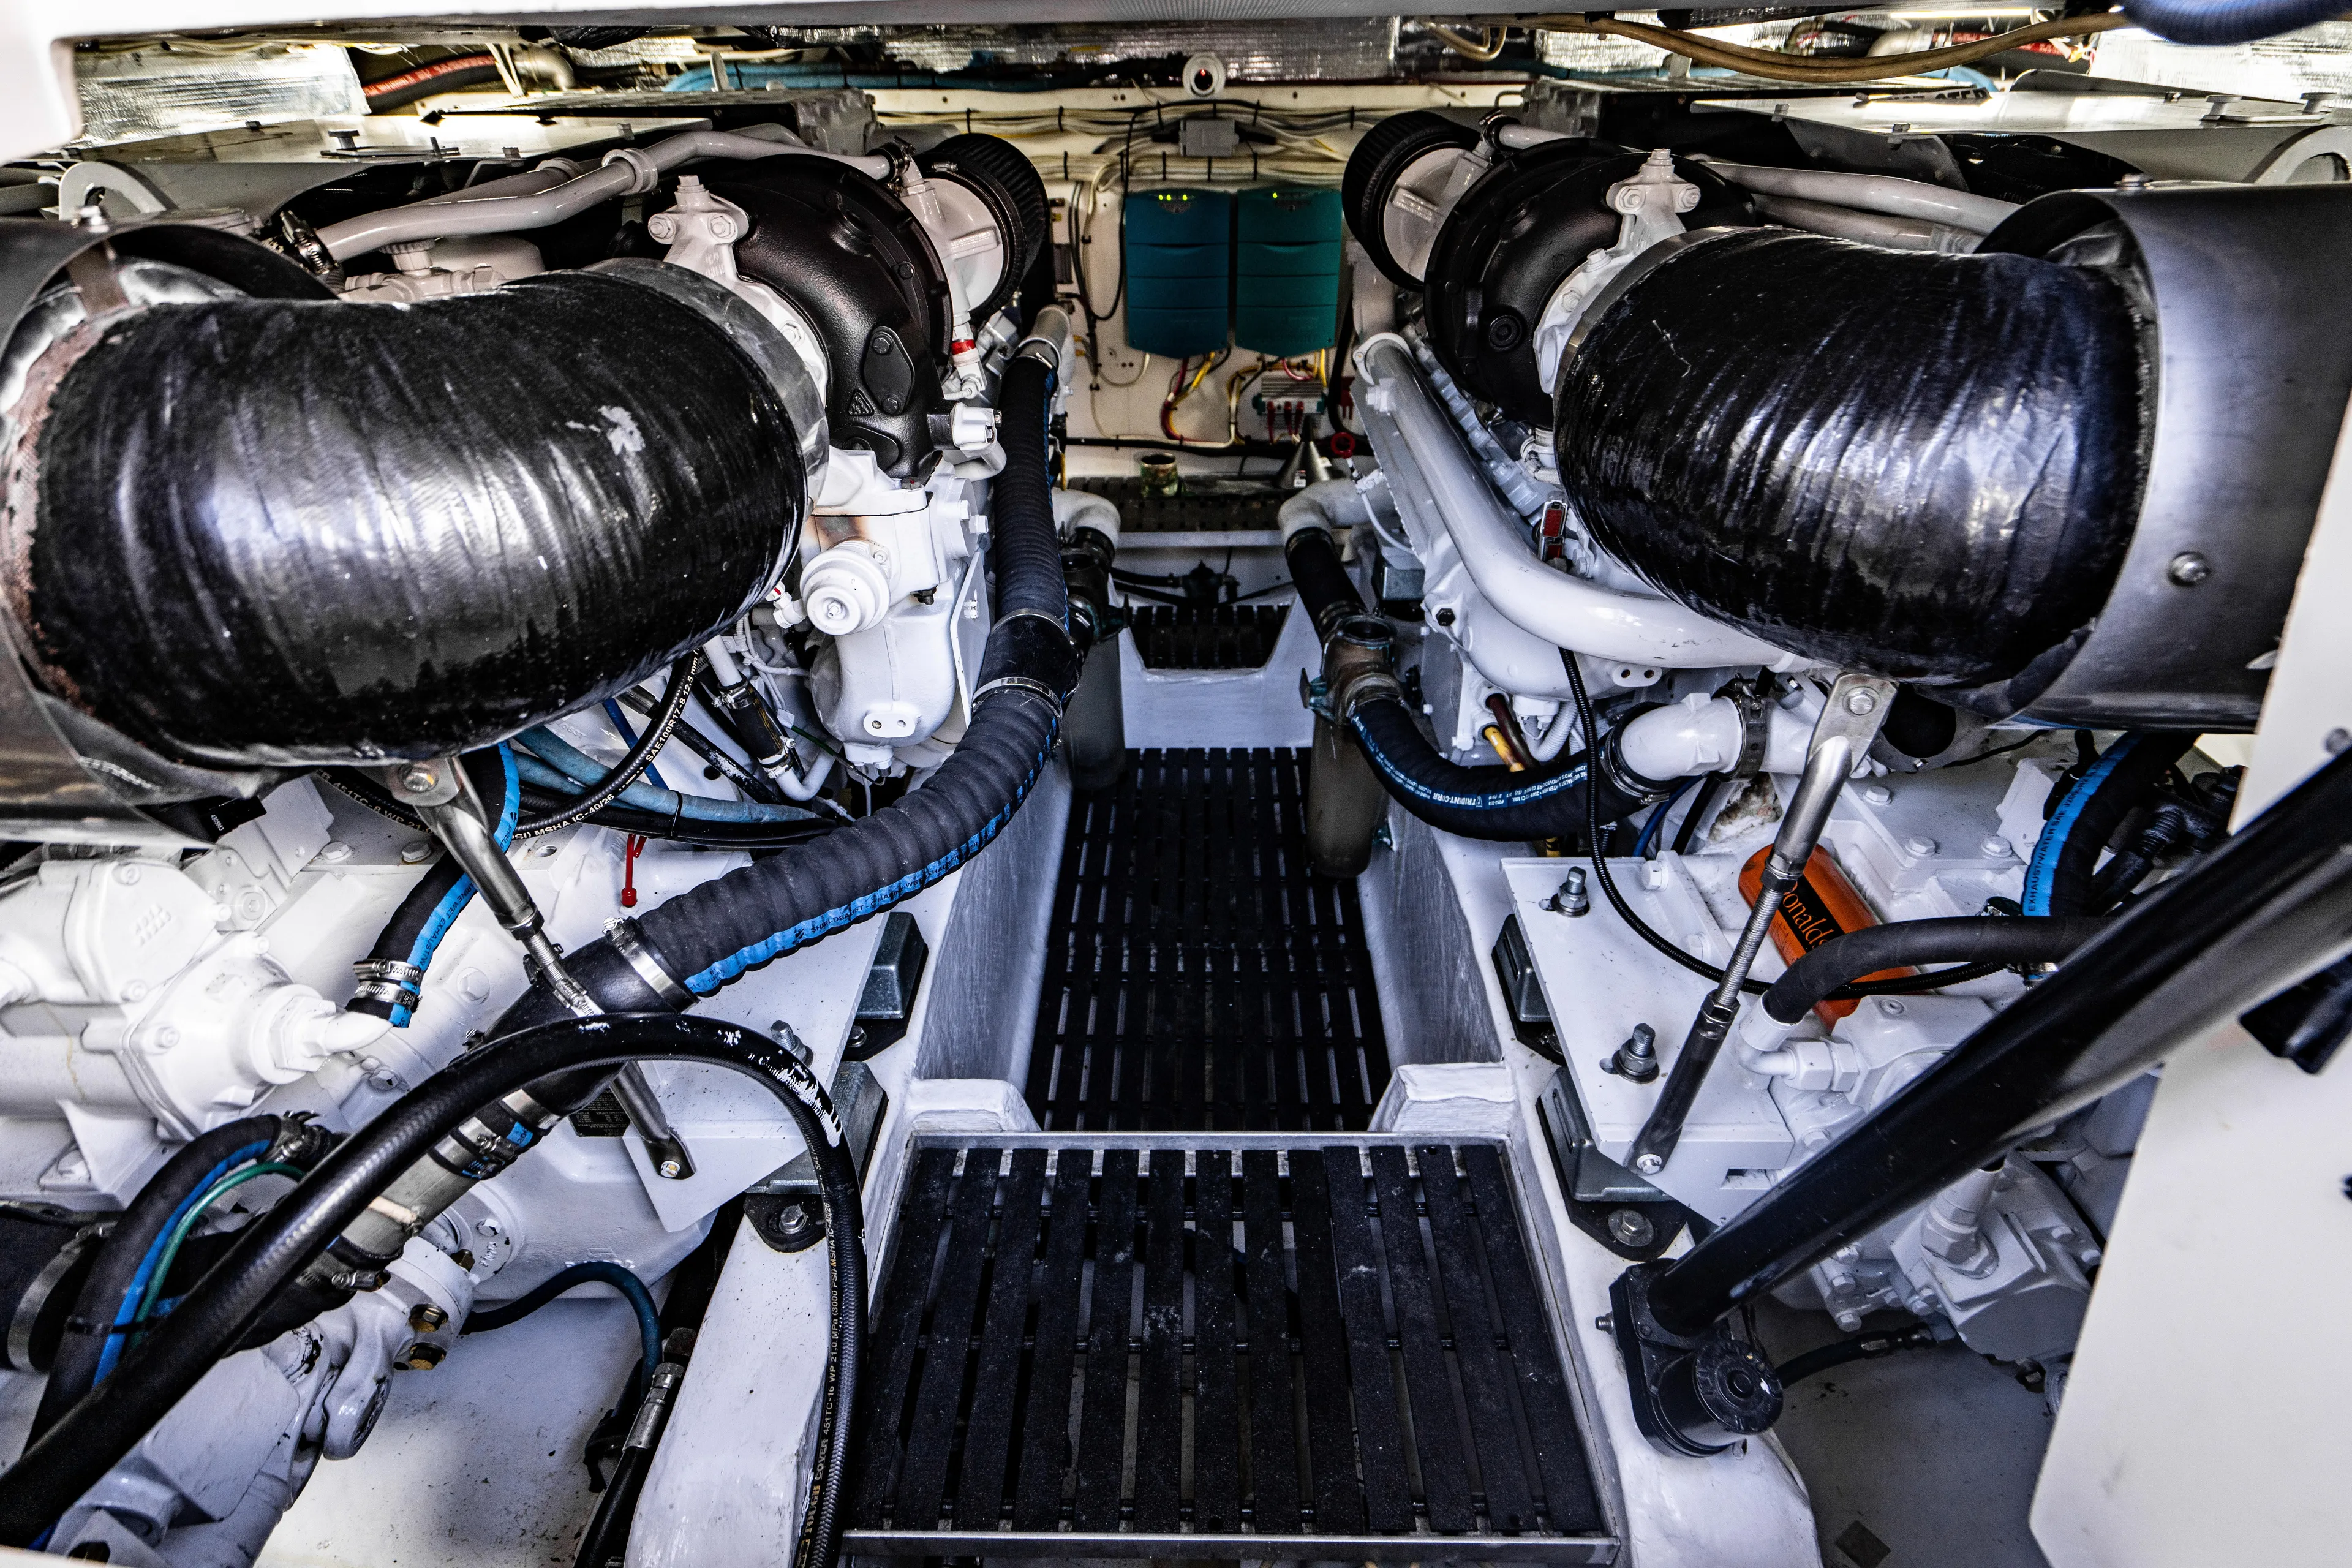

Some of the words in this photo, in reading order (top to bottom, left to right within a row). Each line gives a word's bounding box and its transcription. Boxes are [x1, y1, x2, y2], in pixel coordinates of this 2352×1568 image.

[535, 820, 571, 837] MSHA
[571, 793, 615, 823] IC-40/26
[645, 698, 687, 762] SAE100R17-8
[682, 676, 694, 697] 12.5
[691, 657, 699, 676] mm
[1433, 792, 1476, 807] TRIDENT-CORR
[2028, 827, 2056, 912] EXHAUST/WATER
[446, 902, 459, 919] WET
[824, 1202, 834, 1239] IC-40/26
[826, 1240, 837, 1267] MSHA
[829, 1365, 837, 1382] WP
[823, 1385, 835, 1435] 451TC-16
[814, 1438, 829, 1480] COVER
